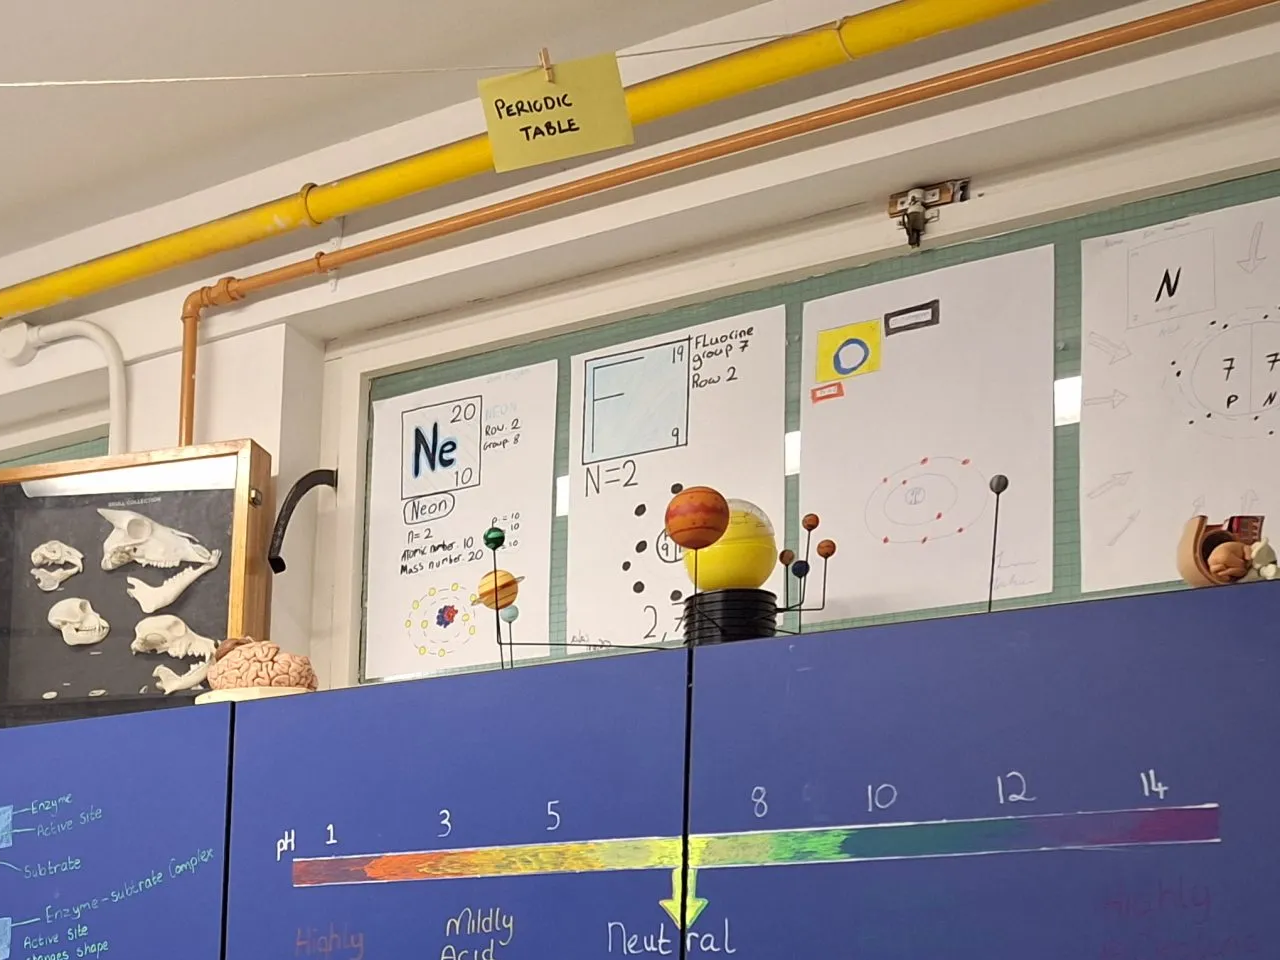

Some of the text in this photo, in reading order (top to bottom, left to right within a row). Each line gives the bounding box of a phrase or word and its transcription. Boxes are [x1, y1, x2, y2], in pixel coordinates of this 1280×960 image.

[494, 94, 573, 120] PERIODIC
[520, 118, 580, 142] TABLE
[1155, 266, 1182, 303] N
[672, 345, 684, 364] 19
[692, 340, 749, 371] group 7
[692, 366, 738, 388] Row 2
[1222, 351, 1280, 381] 7 7
[1226, 391, 1278, 409] P N
[450, 403, 477, 424] 20
[511, 418, 521, 431] 2
[513, 434, 521, 445] 8
[671, 427, 680, 447] 9
[414, 421, 458, 478] Ne
[453, 466, 474, 486] 10
[411, 499, 448, 522] Neon
[463, 537, 474, 548] 10
[400, 562, 424, 575] Mass
[468, 549, 484, 562] 20
[31, 793, 73, 817] Enzyme
[276, 769, 1170, 861] pH 1 3 5 8 10 12 14
[37, 820, 73, 837] Active
[24, 856, 81, 879] Subtrate
[446, 906, 514, 946] Mildly
[23, 932, 59, 950] Active
[76, 940, 109, 960] shape
